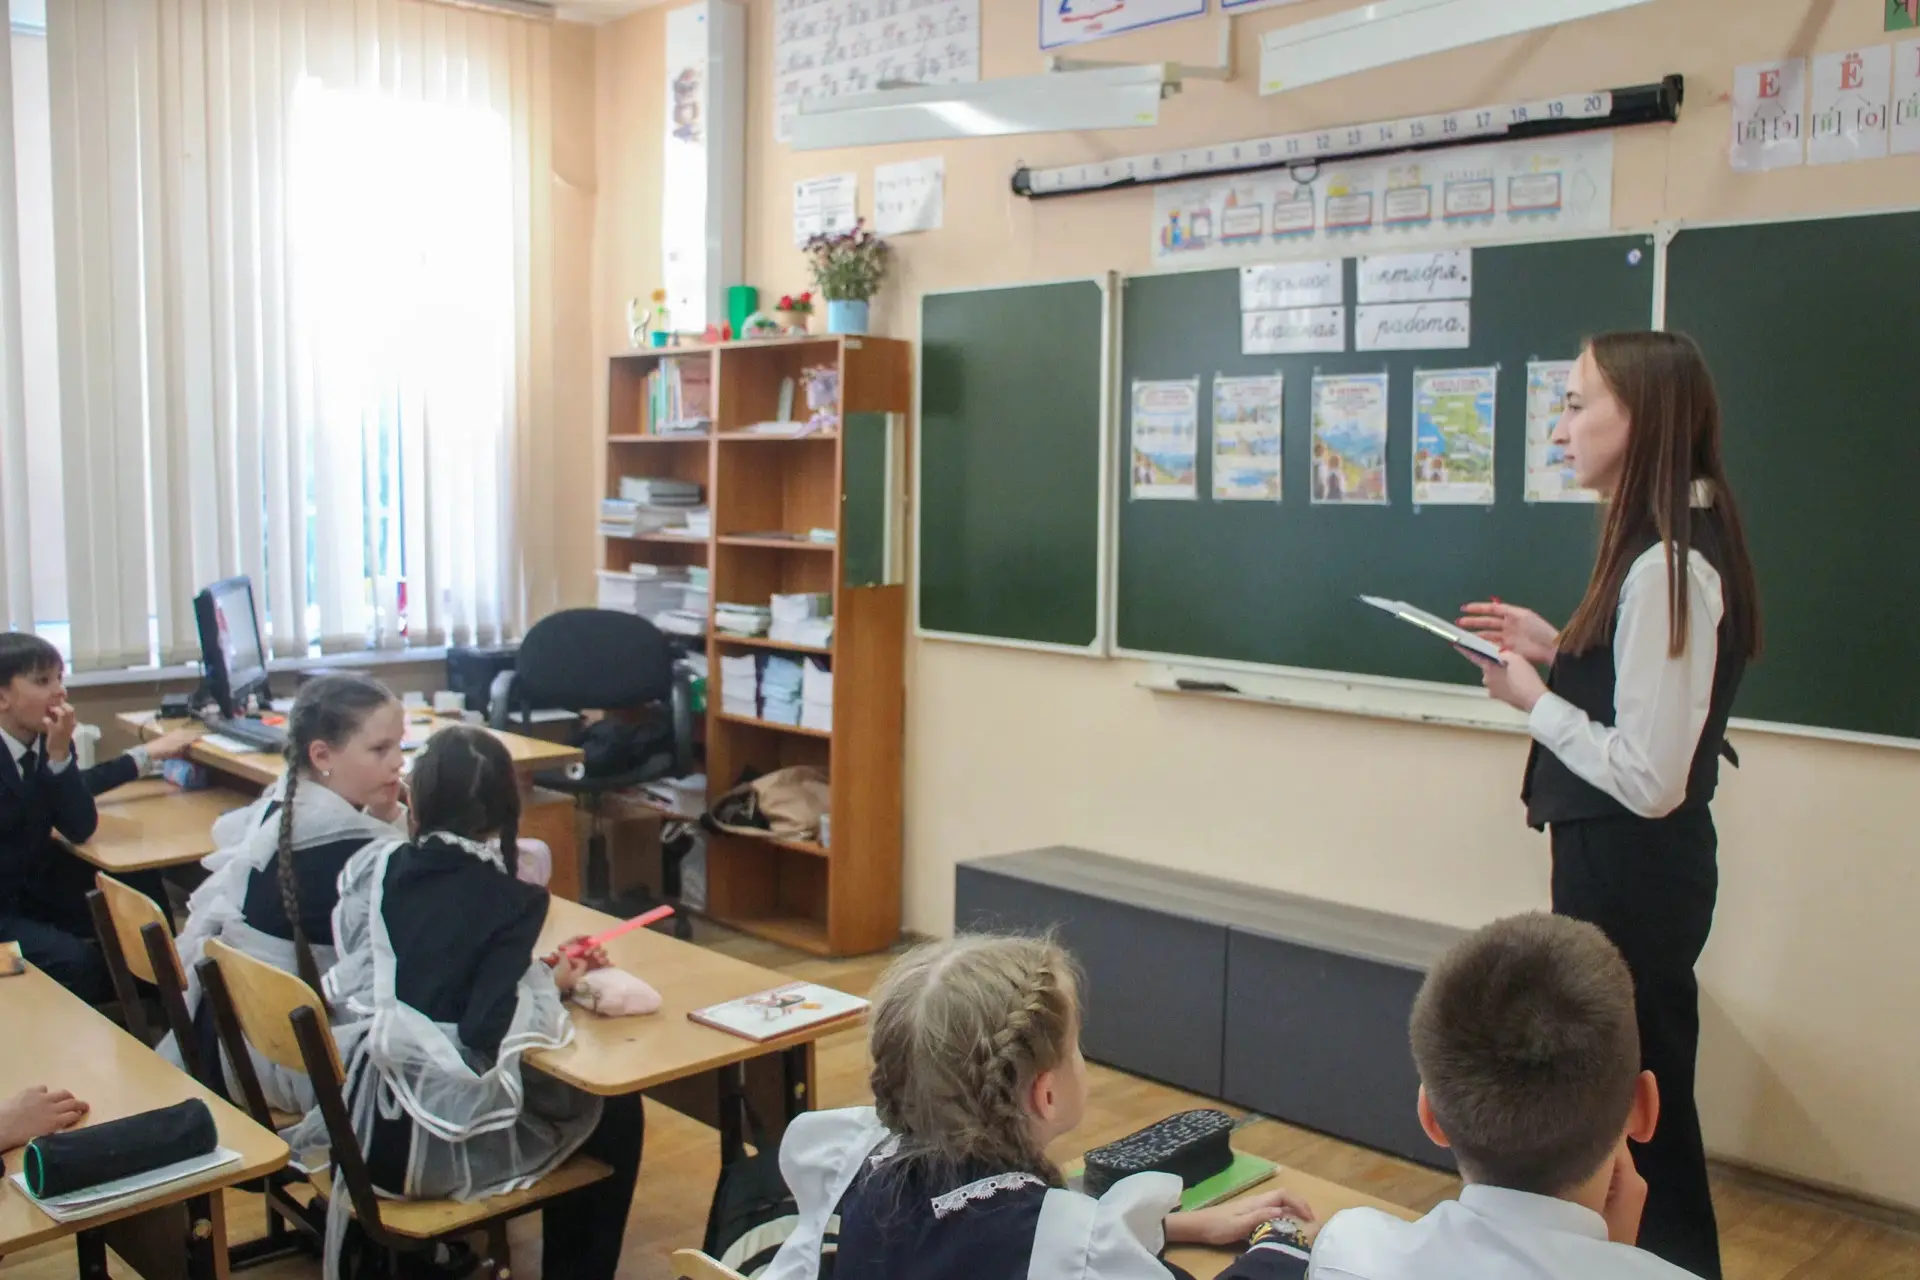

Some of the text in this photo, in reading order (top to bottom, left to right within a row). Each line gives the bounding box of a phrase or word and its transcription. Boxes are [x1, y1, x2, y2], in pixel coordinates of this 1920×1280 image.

[1757, 69, 1780, 98] Е
[1839, 53, 1863, 90] Ё
[1057, 172, 1064, 184] 2
[1153, 157, 1161, 171] 6
[1181, 154, 1188, 167] 7
[1258, 143, 1272, 157] 10
[1286, 139, 1299, 154] 11
[1316, 135, 1329, 150] 12
[1348, 130, 1361, 146] 13
[1379, 126, 1393, 142] 14
[1410, 122, 1424, 138] 15
[1443, 118, 1457, 133] 16
[1476, 112, 1491, 128] 17
[1511, 107, 1526, 122] 18
[1547, 102, 1563, 117] 19
[1584, 96, 1601, 112] 20
